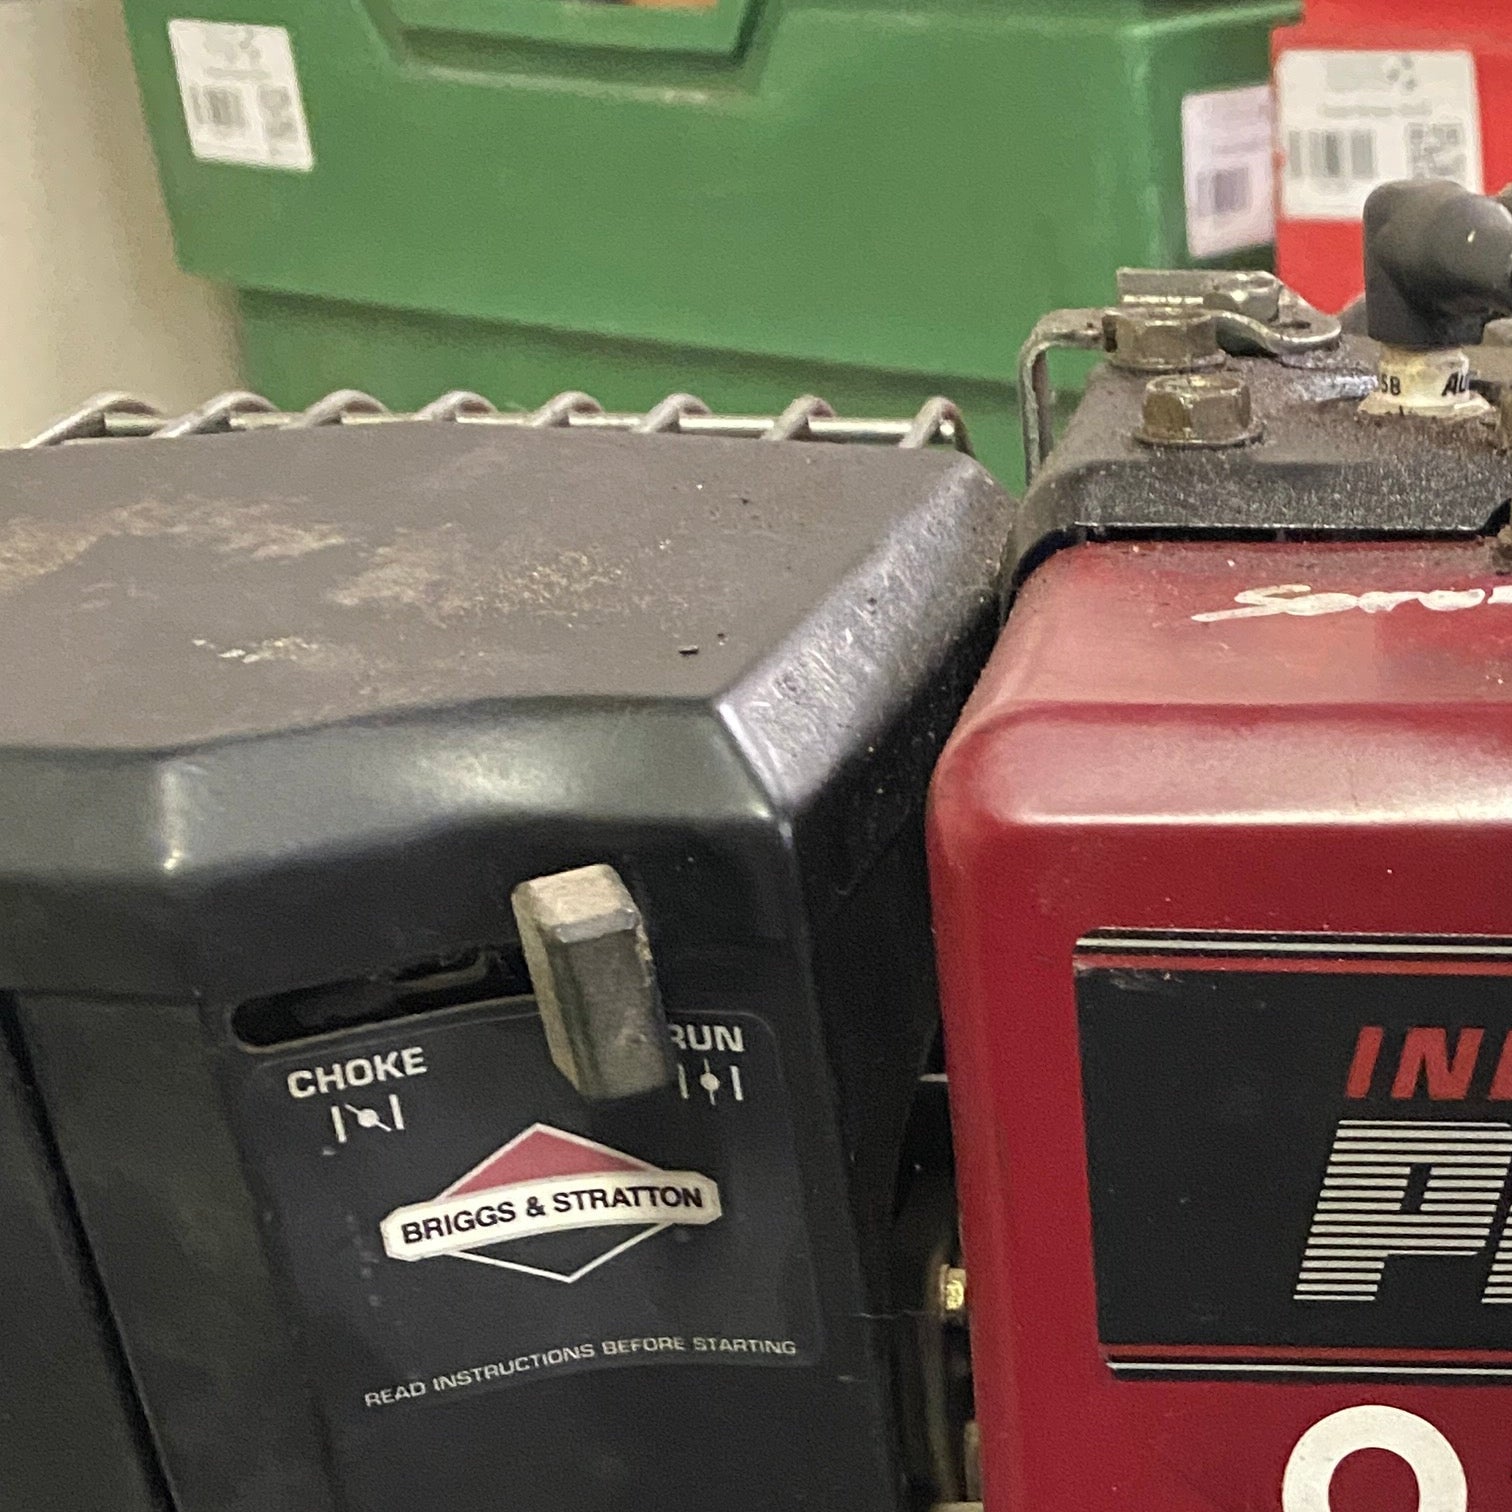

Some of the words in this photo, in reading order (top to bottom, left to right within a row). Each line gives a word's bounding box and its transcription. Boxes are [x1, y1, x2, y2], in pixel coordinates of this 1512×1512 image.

[667, 1023, 745, 1052] RUN
[287, 1046, 428, 1098] CHOKE
[401, 1201, 516, 1244] BRIGGS
[526, 1197, 546, 1218] &
[552, 1185, 704, 1214] STRATTON
[364, 1380, 427, 1407] READ
[432, 1342, 596, 1392] INSTRUCTIONS
[602, 1335, 685, 1356] BEFORE
[693, 1336, 797, 1356] STARTING
